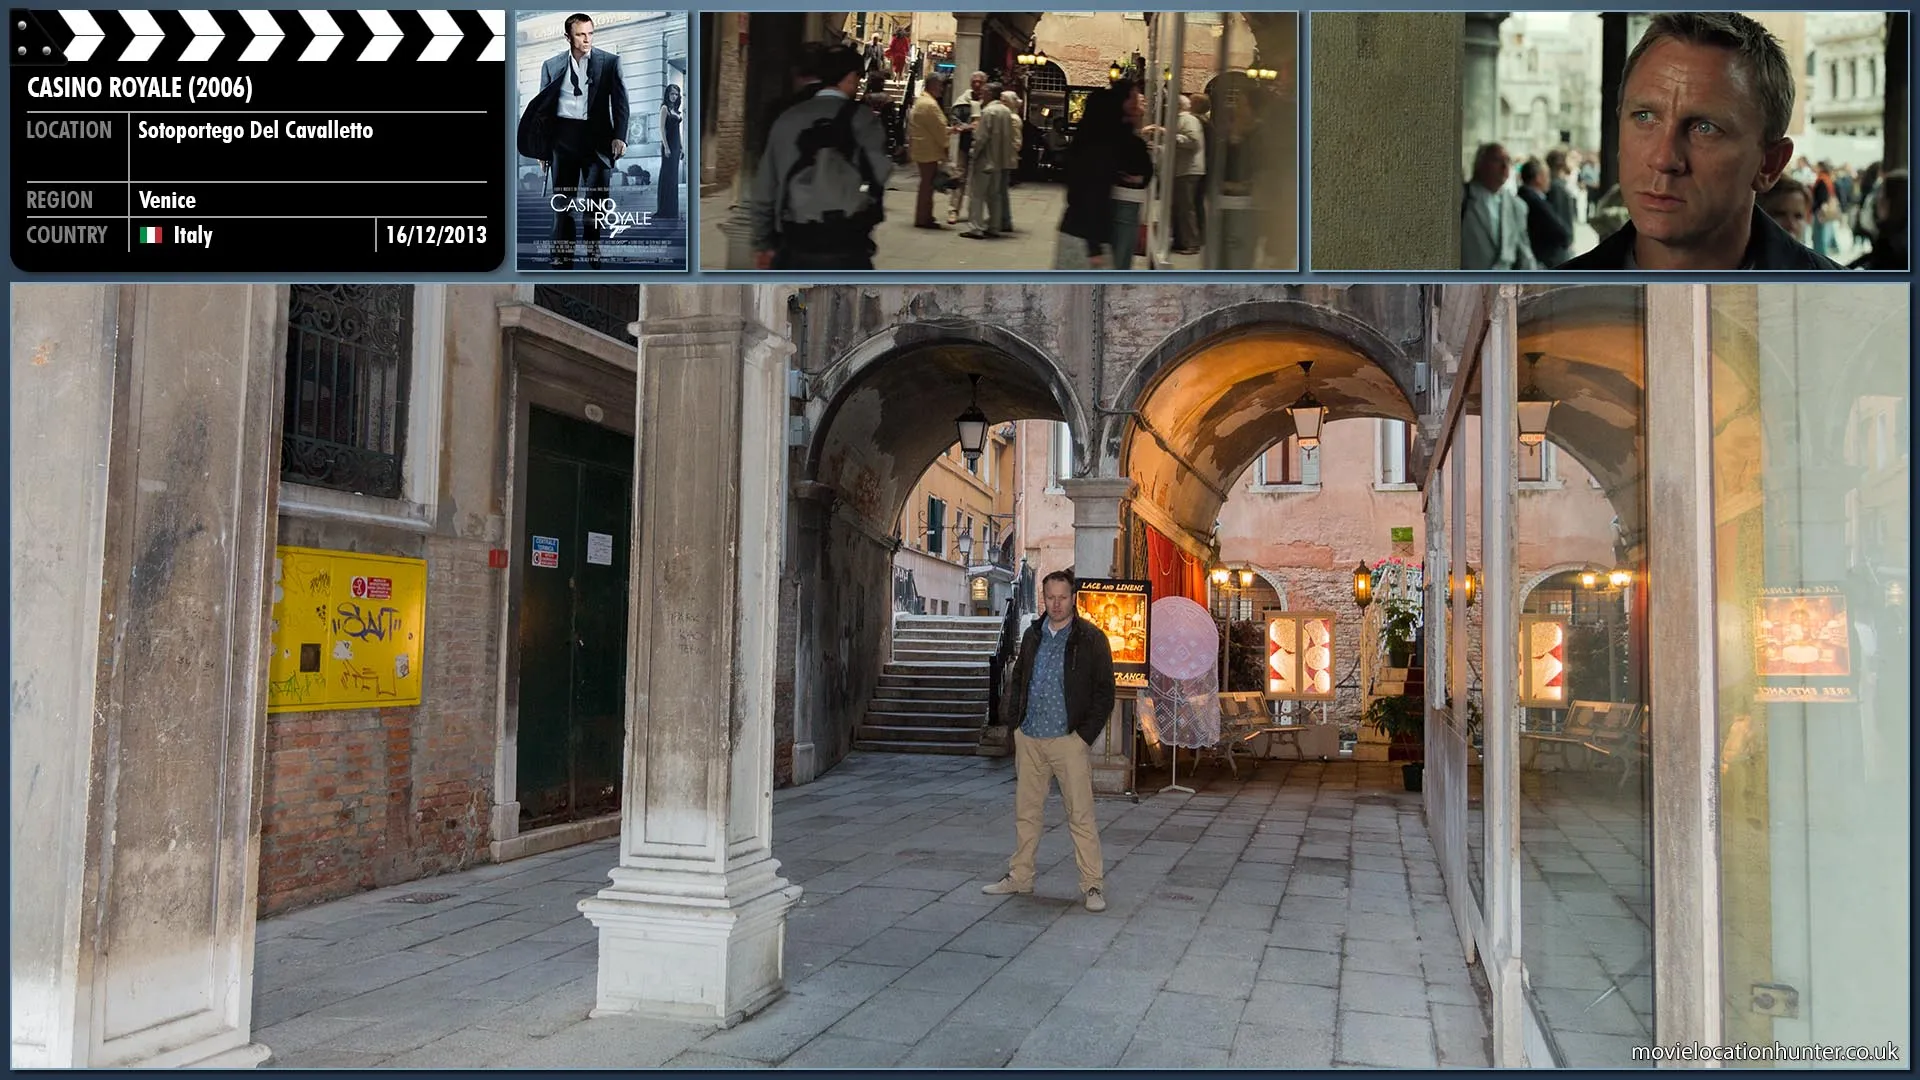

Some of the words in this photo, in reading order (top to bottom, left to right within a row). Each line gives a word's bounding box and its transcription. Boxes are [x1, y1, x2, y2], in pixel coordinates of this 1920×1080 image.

[550, 193, 617, 213] CASINO
[594, 211, 652, 230] ROYALE
[1081, 582, 1101, 590] LACE
[1115, 583, 1145, 592] LINENS
